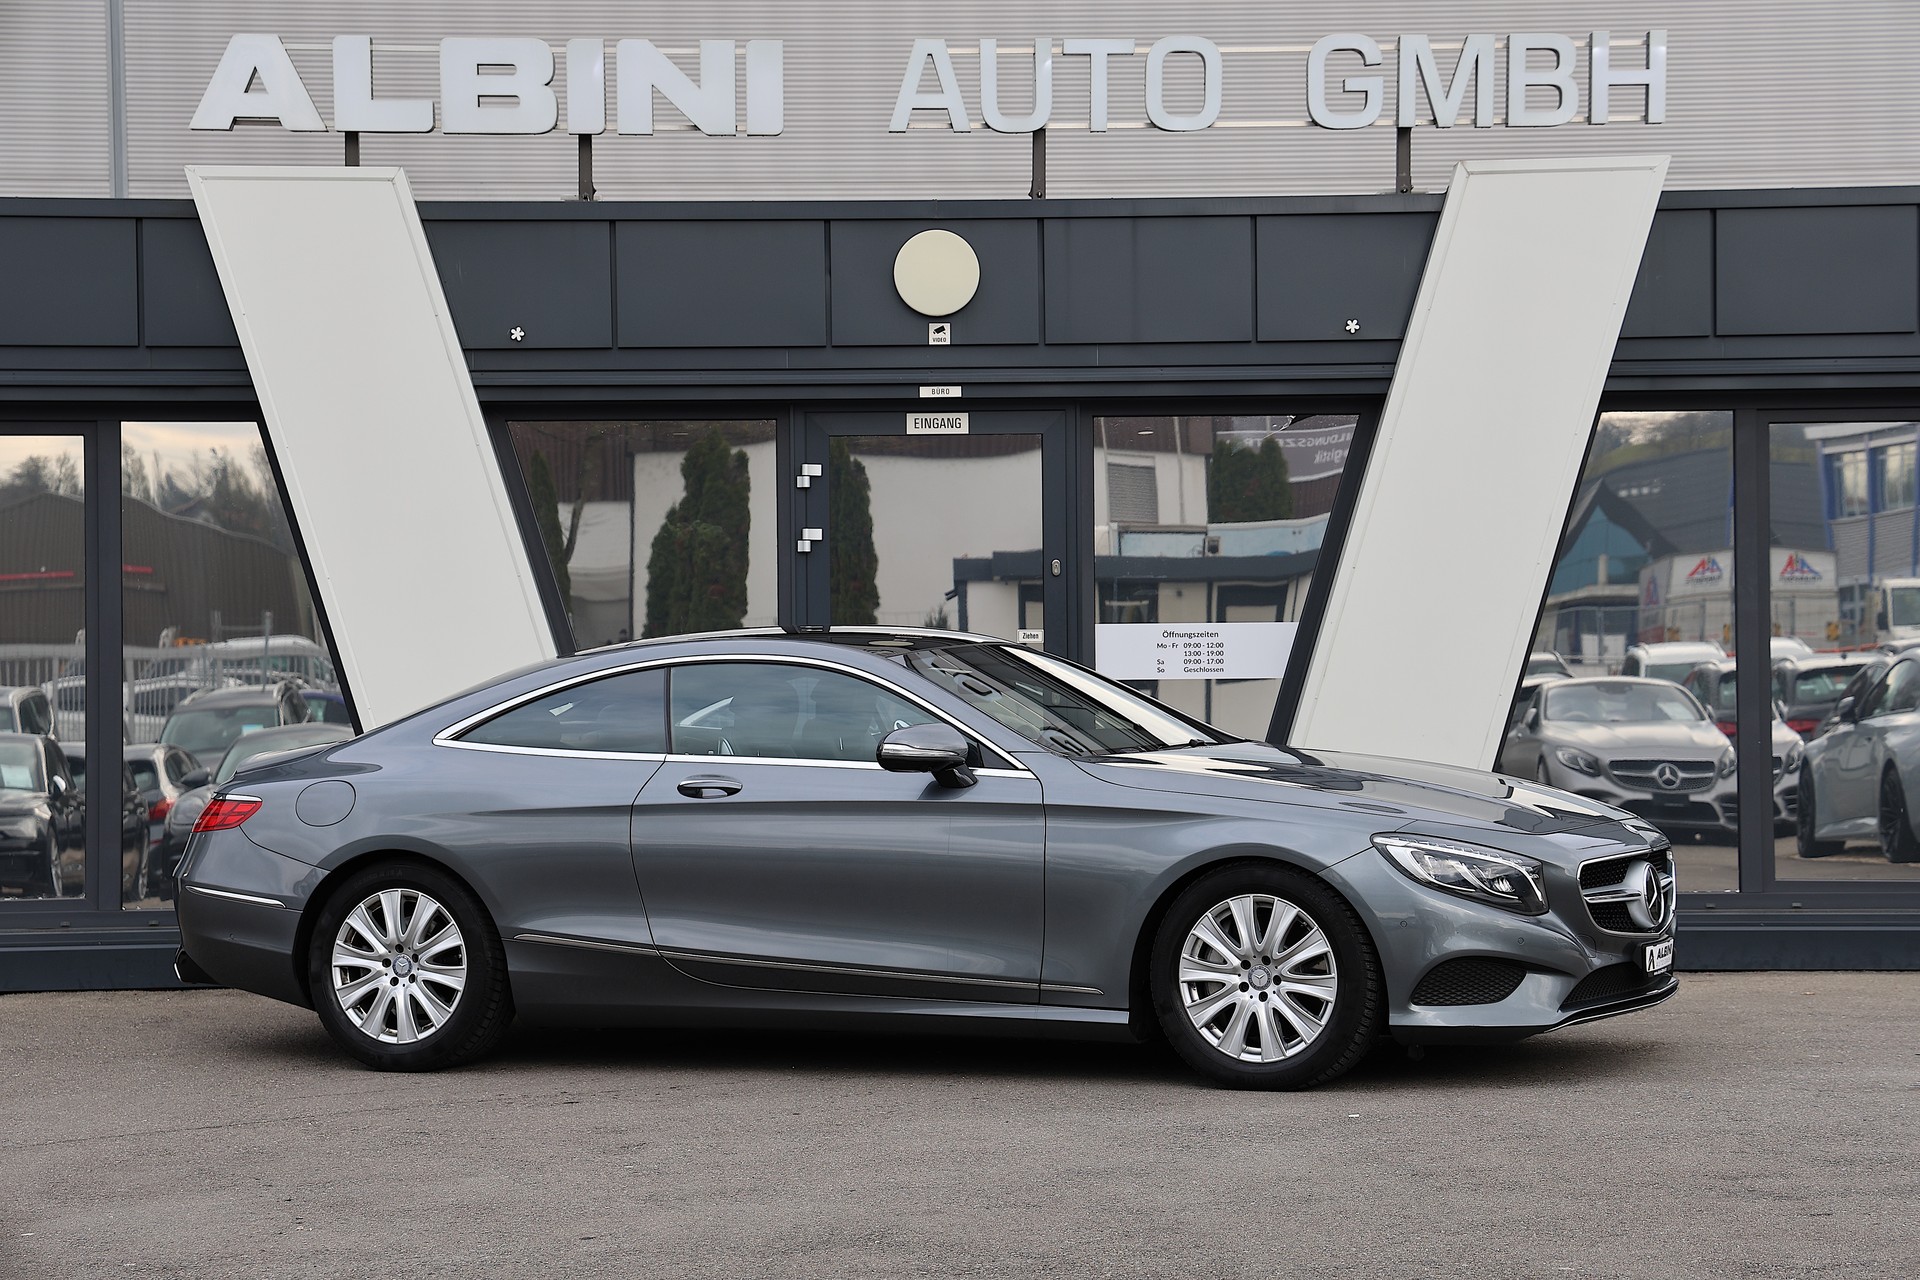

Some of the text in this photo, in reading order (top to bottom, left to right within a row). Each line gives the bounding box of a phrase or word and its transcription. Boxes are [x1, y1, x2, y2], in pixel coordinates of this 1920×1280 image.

[190, 29, 1668, 136] ALBINI AUTO GMBH
[931, 387, 950, 395] BÜRO
[914, 417, 962, 429] EINGANG
[1162, 630, 1219, 639] Öffnungszeiten
